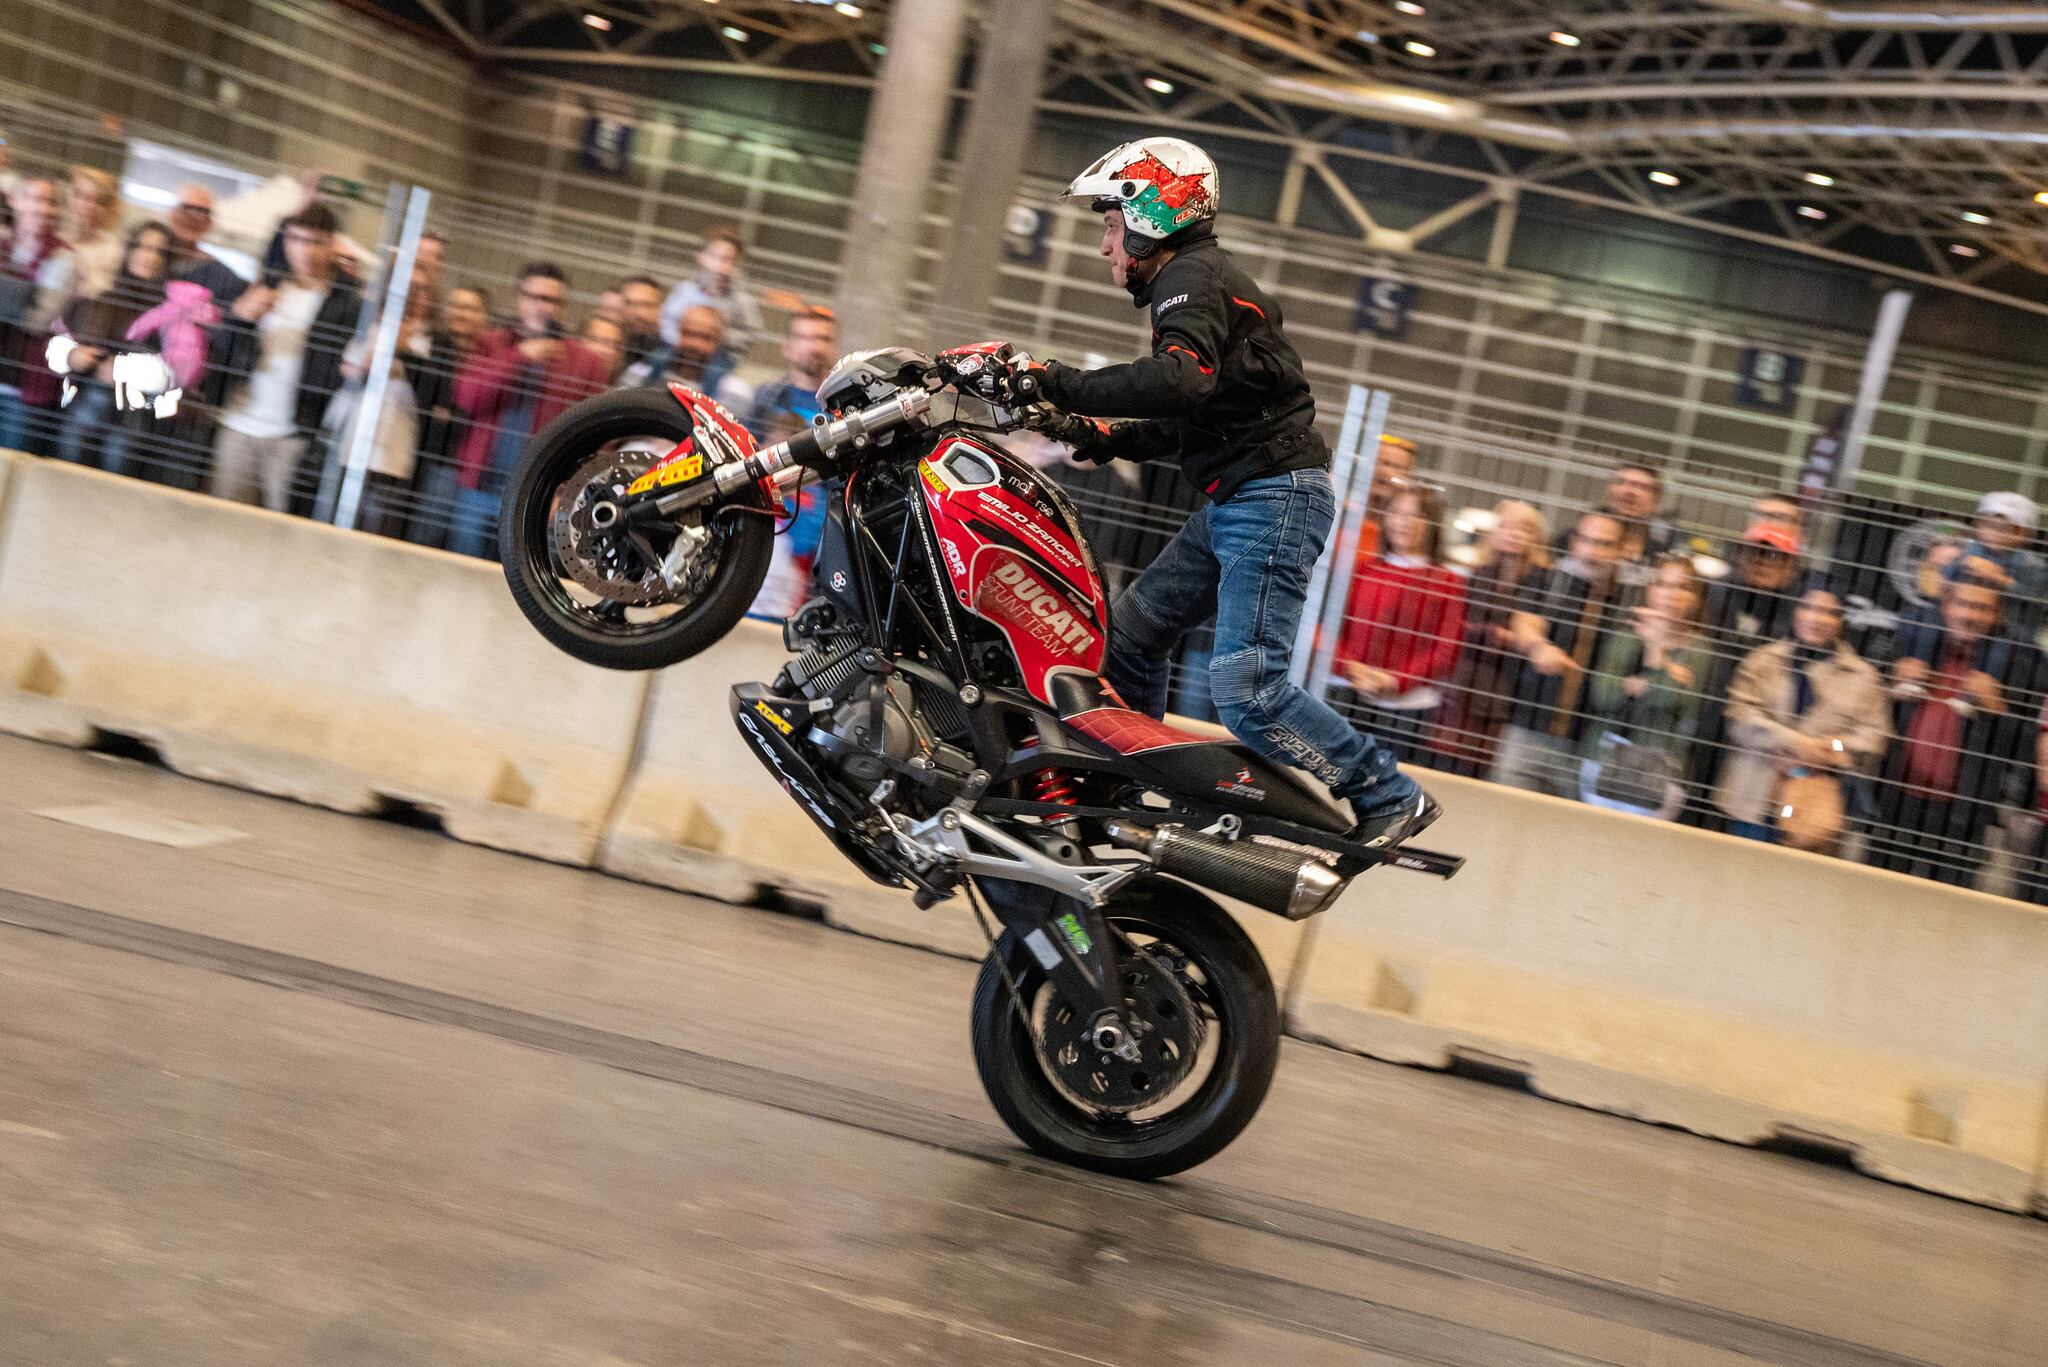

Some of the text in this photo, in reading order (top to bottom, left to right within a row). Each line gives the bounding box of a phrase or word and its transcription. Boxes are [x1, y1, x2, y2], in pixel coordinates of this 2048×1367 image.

[1157, 294, 1189, 315] DUCATI
[942, 537, 967, 576] ADR
[977, 490, 1084, 568] EMILIO ZAMORA
[980, 574, 1031, 620] STUNT
[1025, 613, 1069, 658] TEAM
[994, 560, 1096, 655] DUCATI
